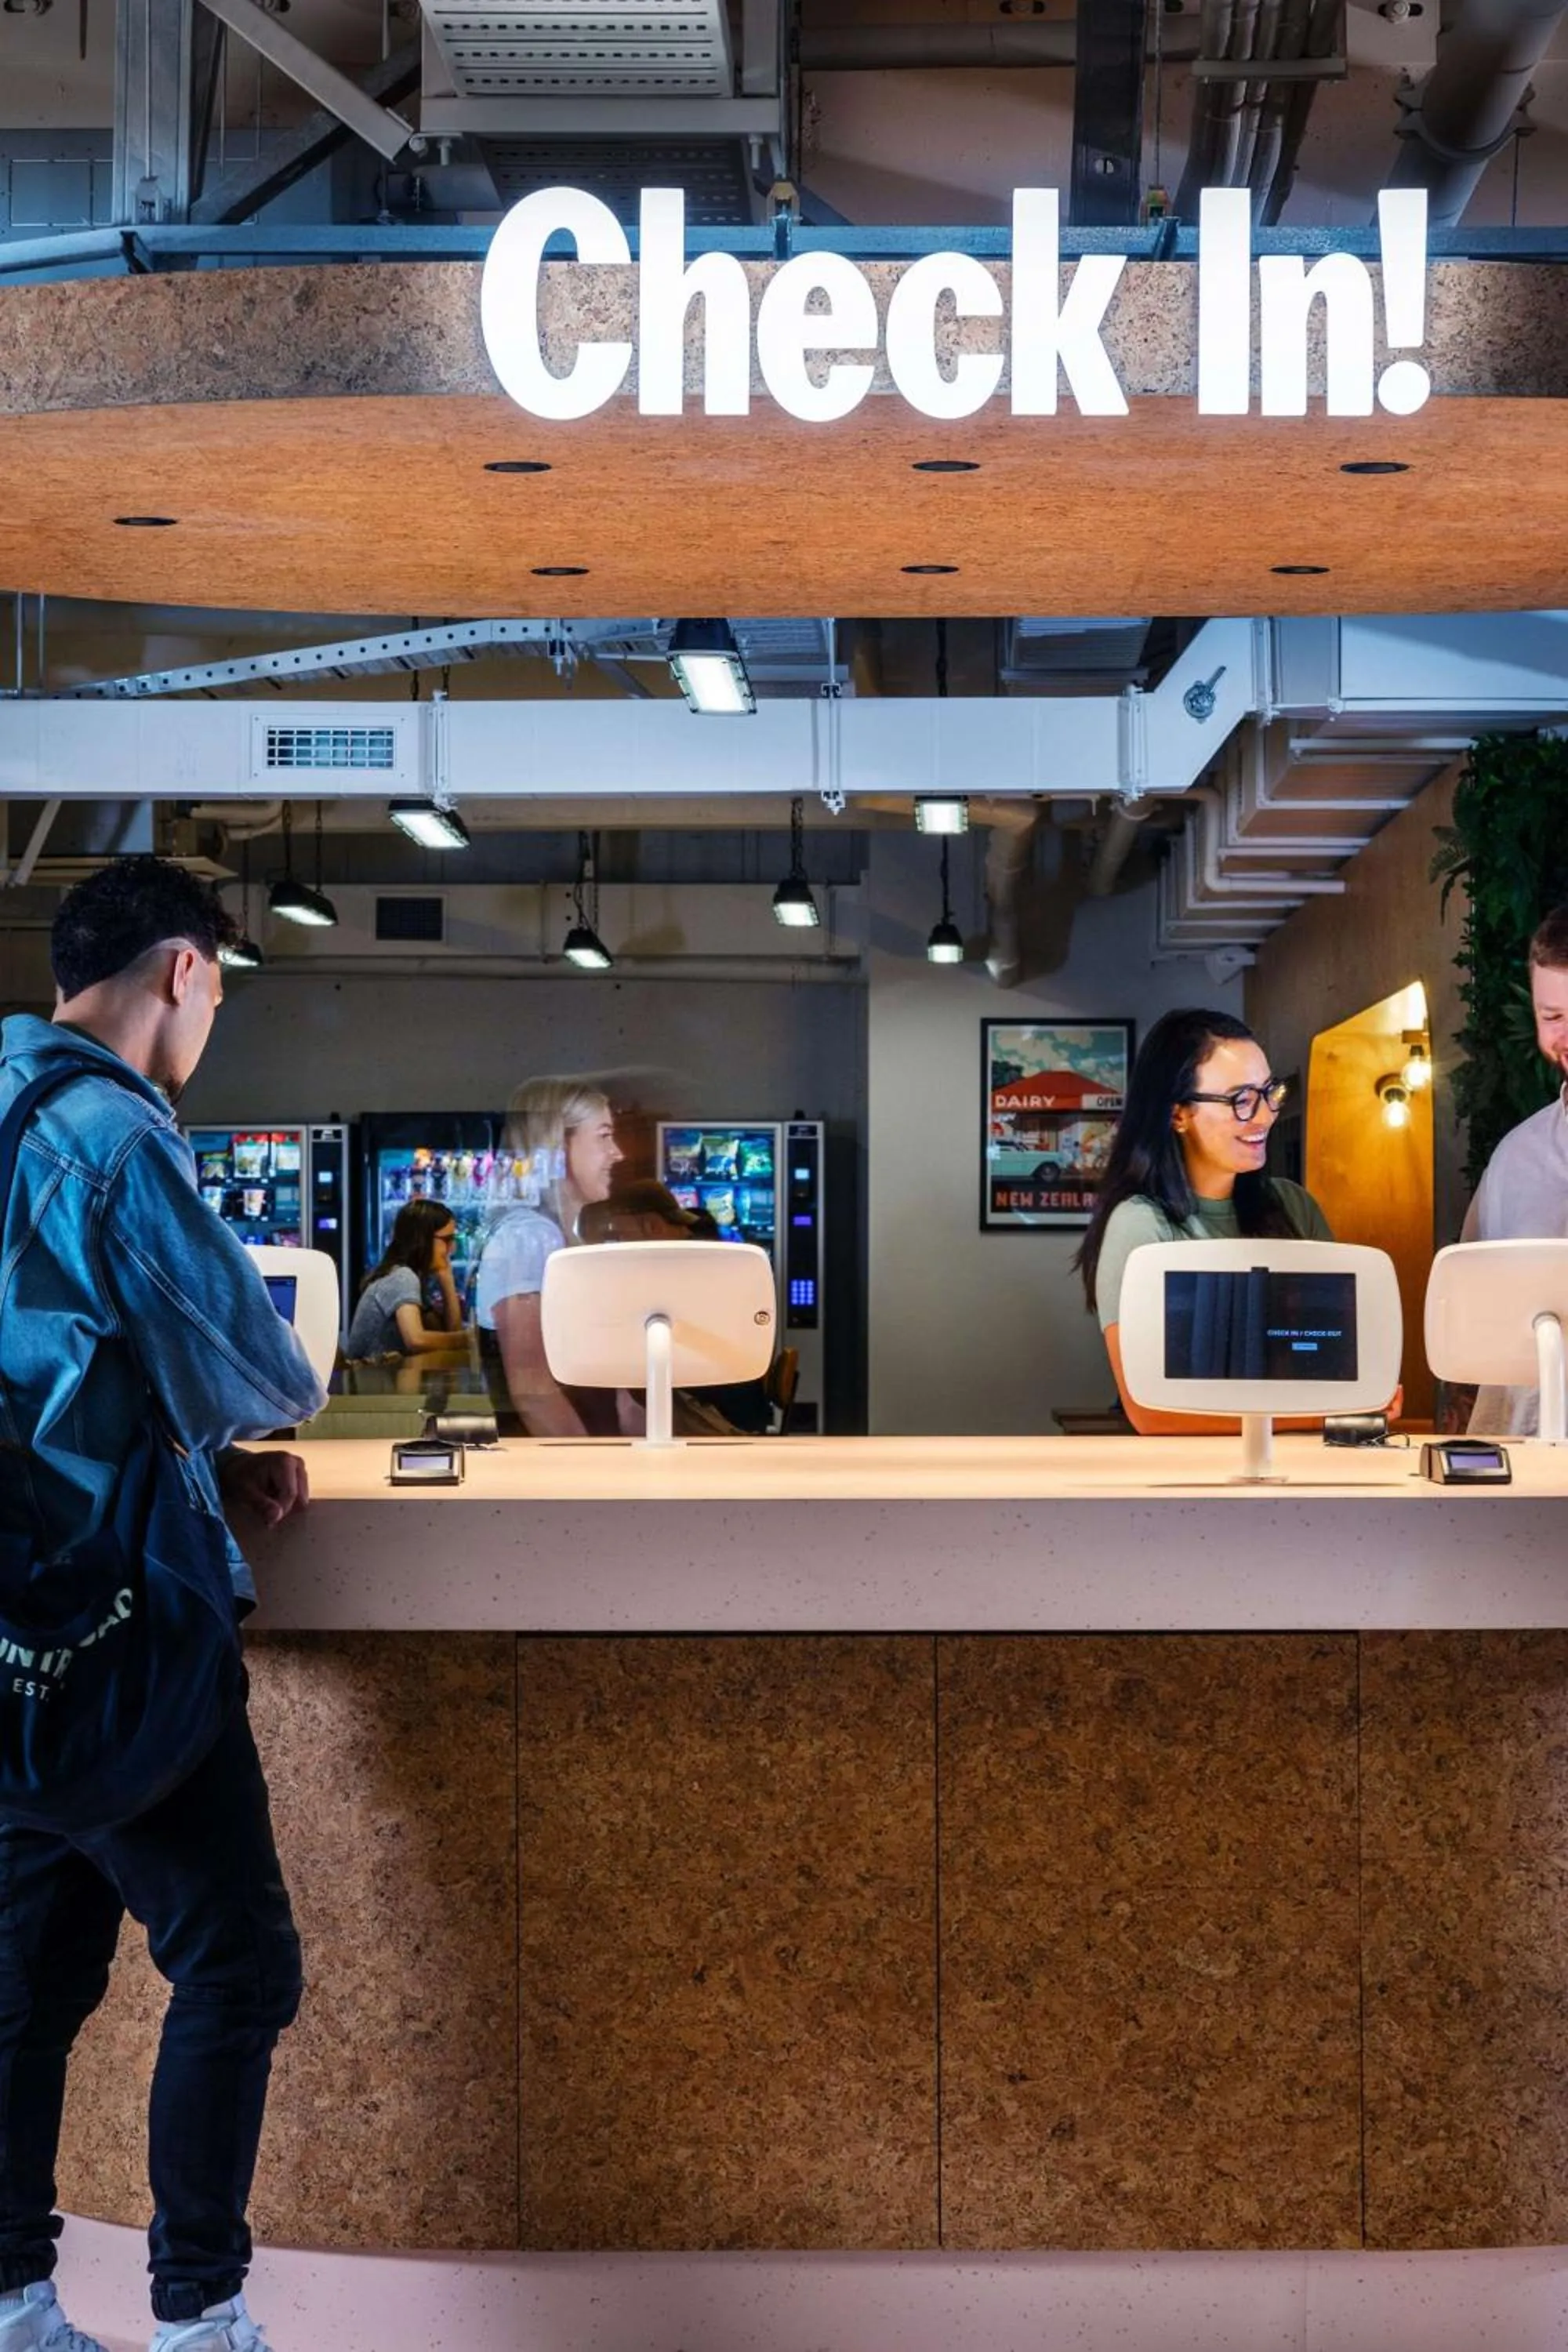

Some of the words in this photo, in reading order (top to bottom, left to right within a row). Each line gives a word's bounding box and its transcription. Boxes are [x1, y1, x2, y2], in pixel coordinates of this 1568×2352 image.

[481, 186, 1130, 423] Check
[1197, 187, 1431, 416] In!
[995, 1095, 1056, 1108] DAIRY
[996, 1192, 1033, 1207] NEW
[1040, 1192, 1094, 1207] ZEALA
